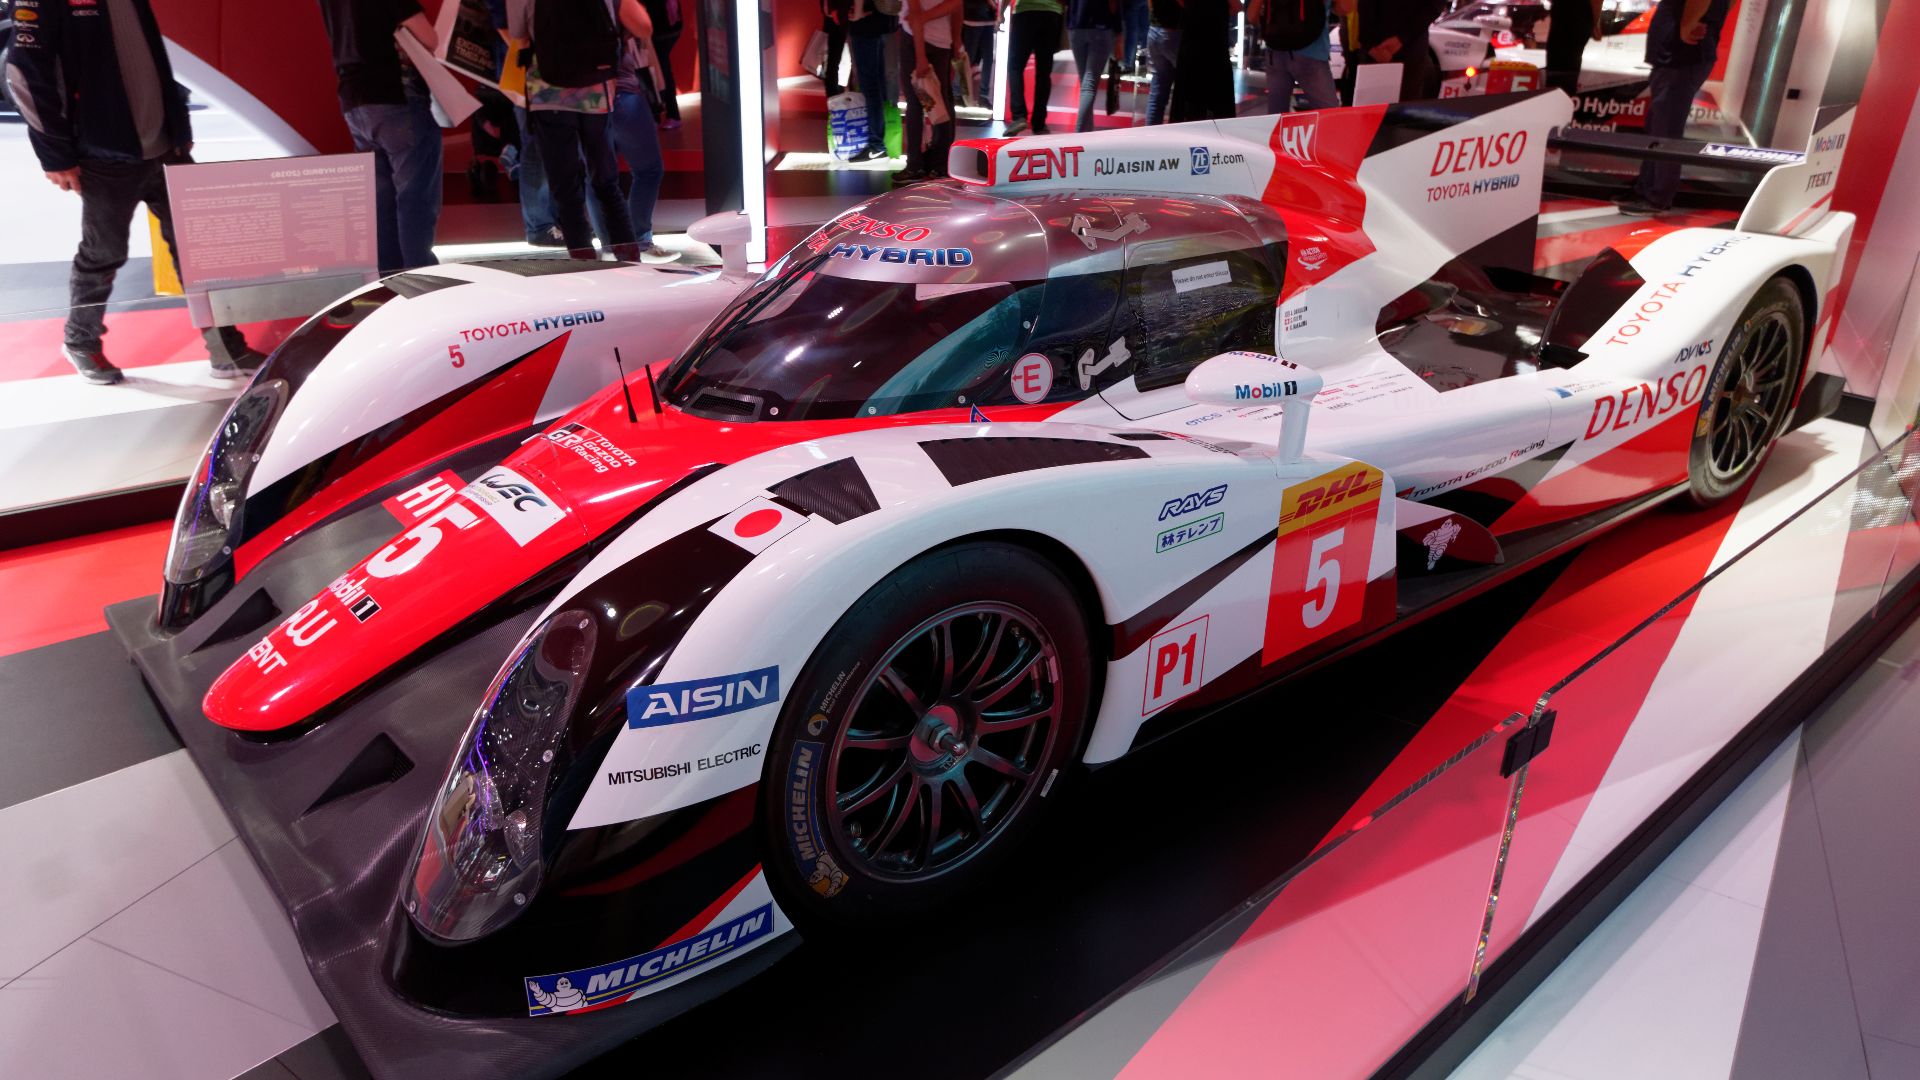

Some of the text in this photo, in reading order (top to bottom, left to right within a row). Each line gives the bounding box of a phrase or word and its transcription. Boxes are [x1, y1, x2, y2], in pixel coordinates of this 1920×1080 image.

[1583, 97, 1645, 117] Hybrid
[1212, 153, 1245, 166] zf.com
[1282, 123, 1315, 162] HY
[1430, 130, 1528, 177] DENSO
[1815, 135, 1837, 153] Mobil
[1008, 146, 1084, 183] ZENT
[1116, 160, 1155, 175] AISIN
[1158, 158, 1180, 171] AW
[1805, 171, 1833, 192] JTEKT
[1427, 174, 1520, 203] TOYOTA HYBRID
[829, 242, 973, 267] HYBRID
[460, 310, 605, 343] TOYOTA HYBRID
[1606, 281, 1686, 345] TOYOTA
[448, 344, 465, 368] 5
[1229, 351, 1278, 363] Mobil
[1023, 363, 1042, 393] E
[1235, 381, 1296, 399] Mobil 1
[1583, 364, 1708, 441] DENSO
[548, 428, 584, 447] GR
[582, 441, 622, 468] GAZOO
[595, 436, 638, 467] TOYOTA
[571, 444, 609, 473] Racing
[1414, 475, 1463, 498] TOYOTA
[1509, 439, 1546, 460] Racing
[396, 476, 456, 518] HY
[479, 473, 548, 512] WEC
[1158, 483, 1228, 521] RAYS
[1293, 470, 1373, 520] DHL
[366, 503, 479, 578] 5
[1161, 516, 1222, 548] 林テレンプ
[1302, 527, 1345, 629] 5
[248, 636, 289, 676] ENT
[1152, 633, 1198, 700] P1
[641, 675, 768, 719] AISIN
[820, 671, 846, 711] MICHELIN
[608, 743, 761, 785] MITSUBISHI ELECTRIC
[791, 746, 817, 861] MICHELIN
[586, 911, 766, 994] MICHELIN
